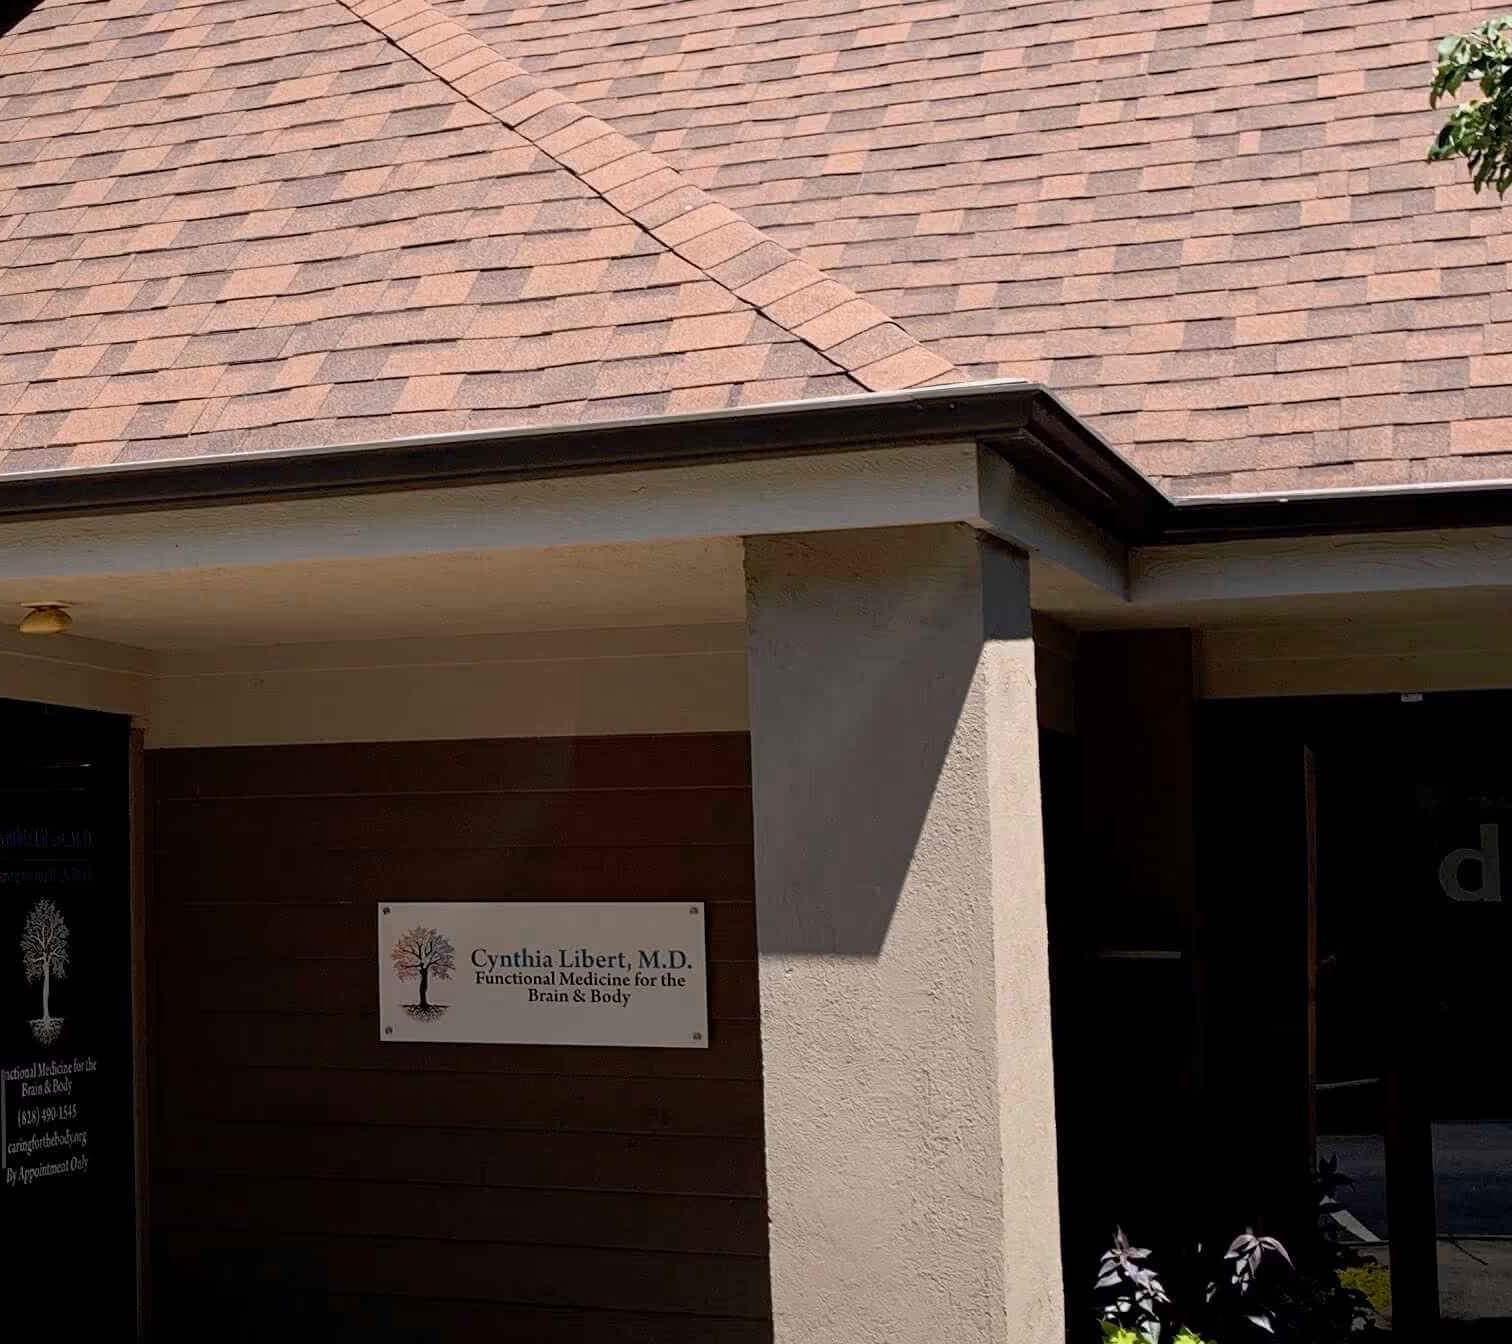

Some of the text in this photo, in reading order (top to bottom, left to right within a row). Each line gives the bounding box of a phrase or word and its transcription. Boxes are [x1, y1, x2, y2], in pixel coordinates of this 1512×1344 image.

[471, 948, 693, 972] Cynthia Libert, M.D.
[475, 971, 687, 988] Functional Medicine for the
[527, 988, 631, 1007] Brain & Body
[2, 1056, 97, 1080] nctional Medicine for the
[21, 1076, 72, 1097] Brain & Body
[17, 1106, 40, 1128] (828)
[6, 1153, 89, 1187] By Appointment Only
